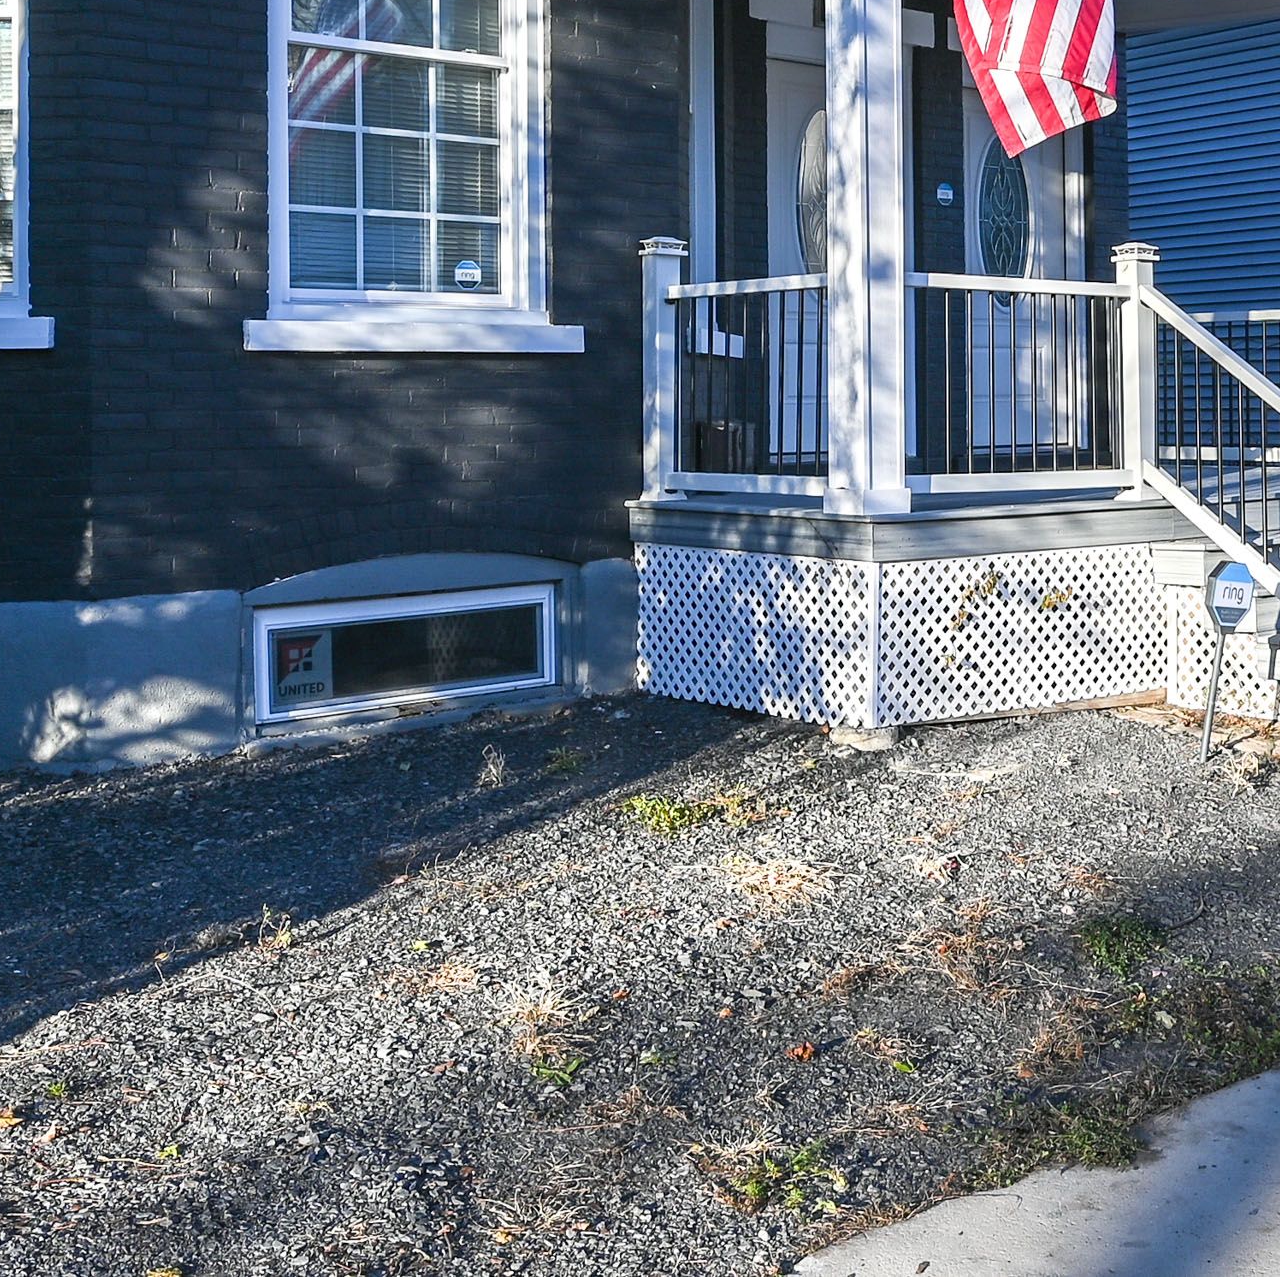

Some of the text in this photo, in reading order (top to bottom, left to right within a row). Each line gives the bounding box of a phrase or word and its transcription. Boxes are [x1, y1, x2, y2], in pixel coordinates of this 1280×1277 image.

[460, 271, 475, 280] ring
[1222, 584, 1244, 605] ring
[278, 681, 325, 697] UNITED
